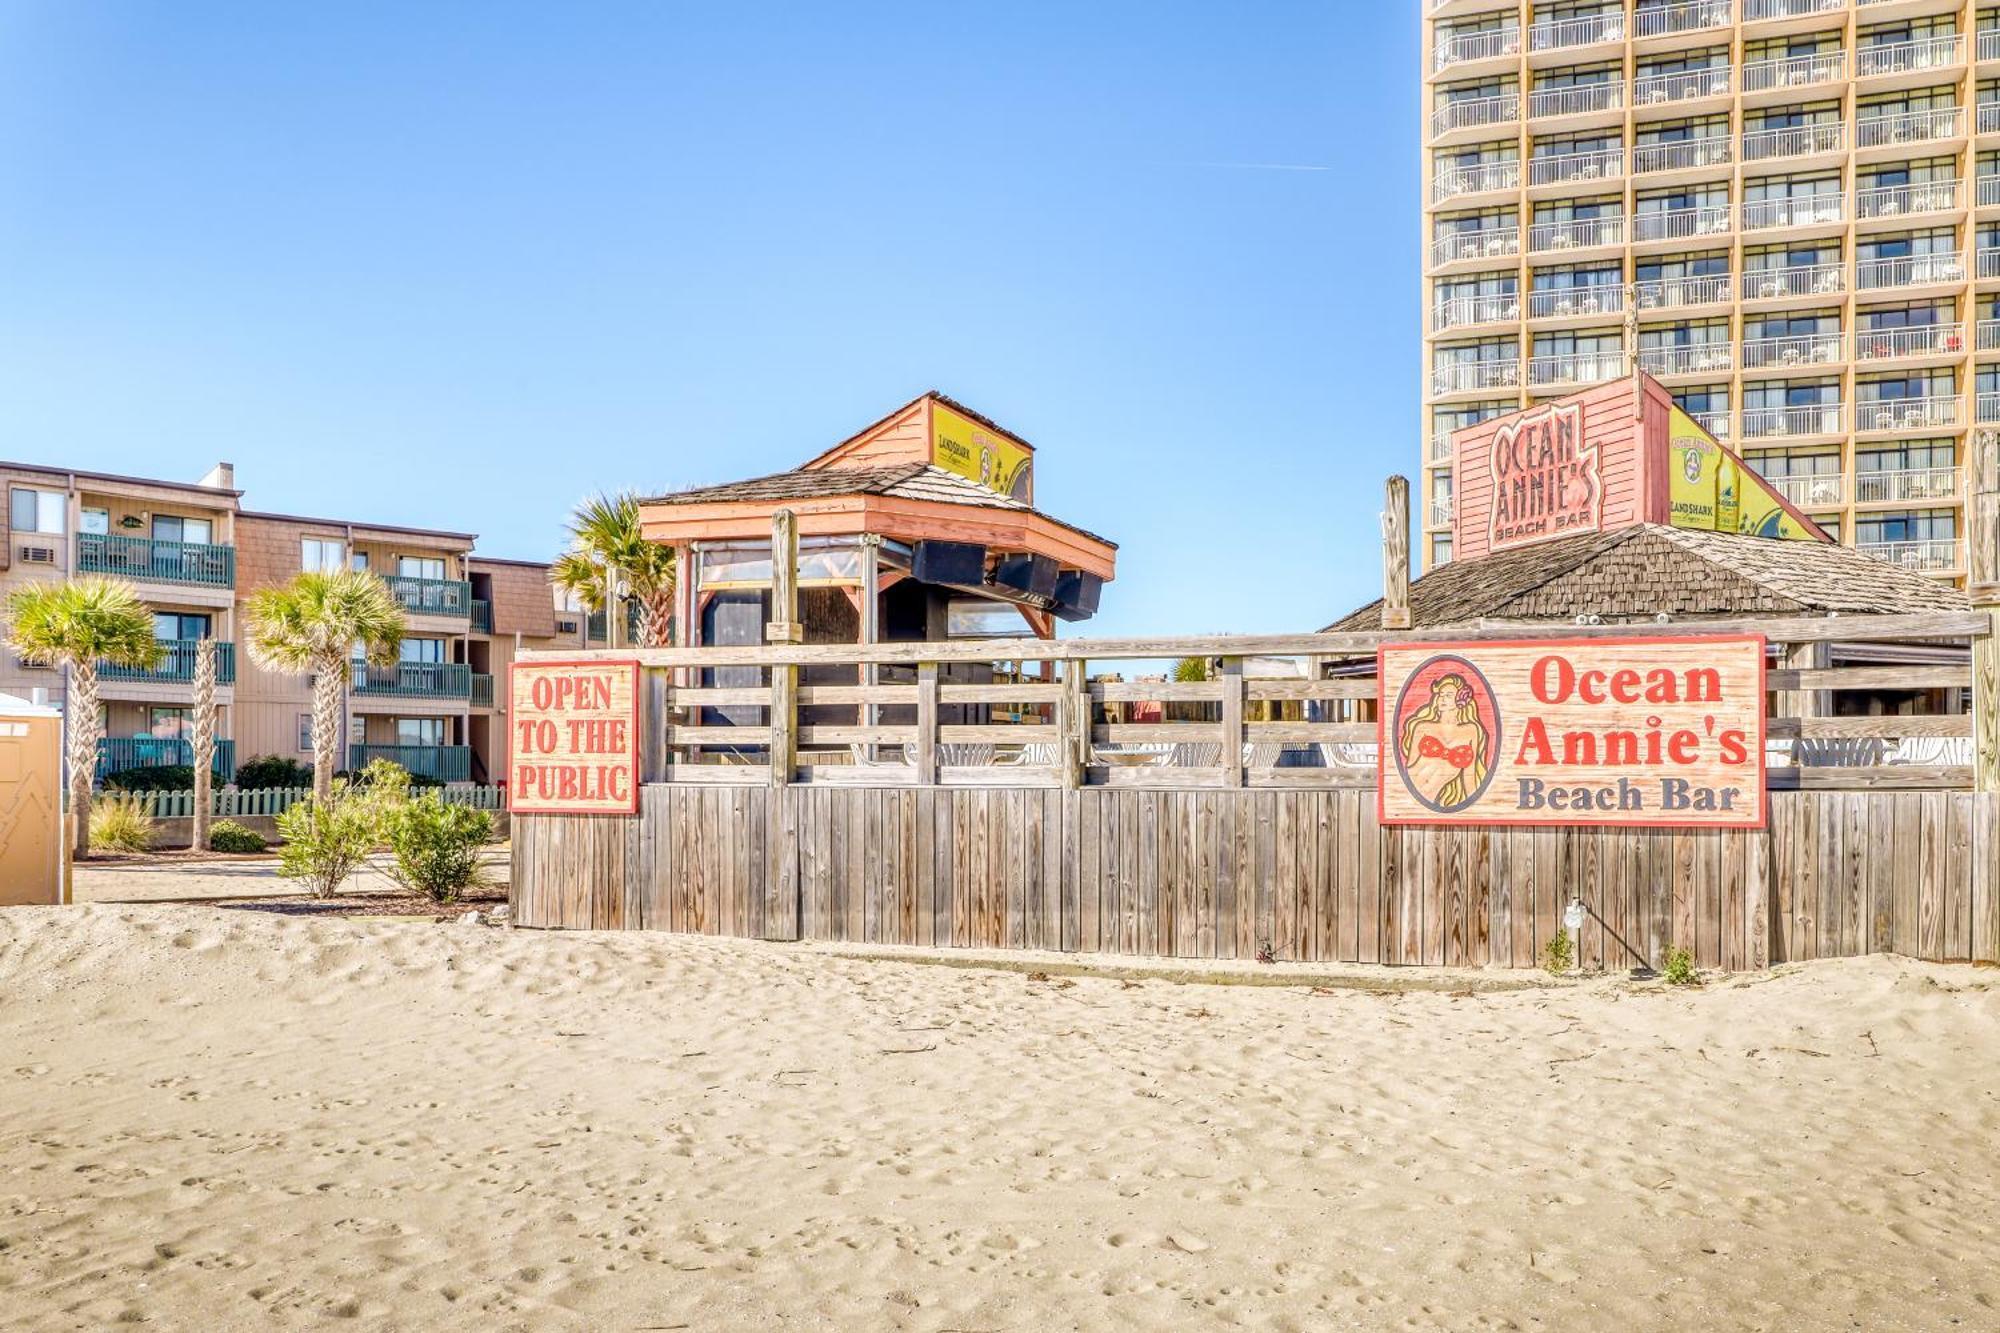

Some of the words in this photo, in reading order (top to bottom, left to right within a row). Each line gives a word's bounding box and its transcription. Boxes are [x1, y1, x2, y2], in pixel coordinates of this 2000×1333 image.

[1495, 415, 1574, 478] OCEAN
[1496, 459, 1594, 522] ANNIE'S
[1495, 518, 1547, 540] BEACH
[1555, 511, 1591, 529] BAR
[532, 676, 612, 711] OPEN
[1530, 655, 1723, 704] Ocean
[519, 719, 558, 754] TO
[566, 719, 626, 754] THE
[1513, 715, 1748, 766] Annie's
[517, 764, 628, 802] PUBLIC
[1516, 777, 1642, 811] Beach
[1659, 777, 1740, 811] Bar
